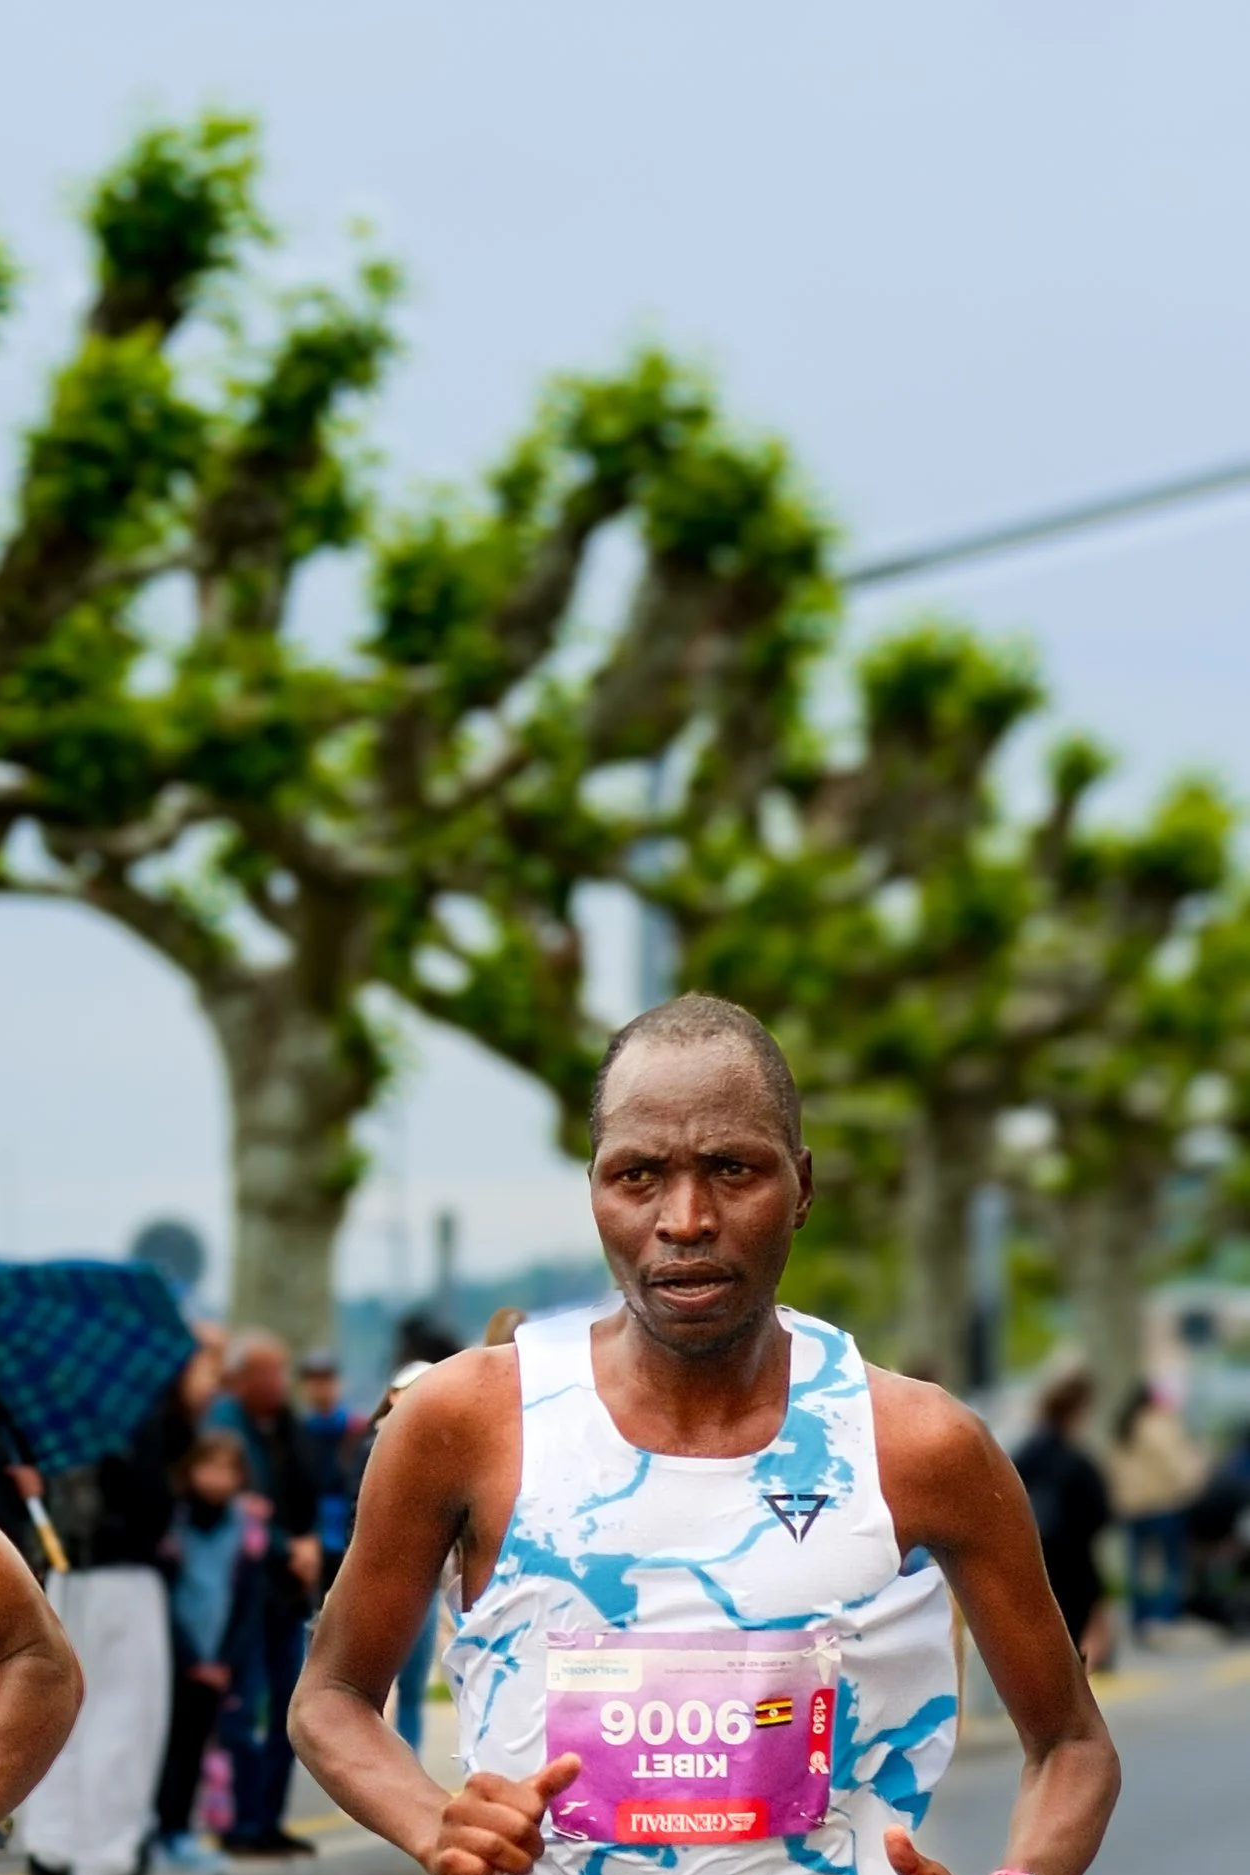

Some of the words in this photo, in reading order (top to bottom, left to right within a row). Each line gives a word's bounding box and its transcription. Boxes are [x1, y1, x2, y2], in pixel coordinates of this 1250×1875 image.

[600, 1700, 751, 1746] 9006
[632, 1753, 728, 1778] KIBET
[630, 1813, 728, 1833] GENERALI
